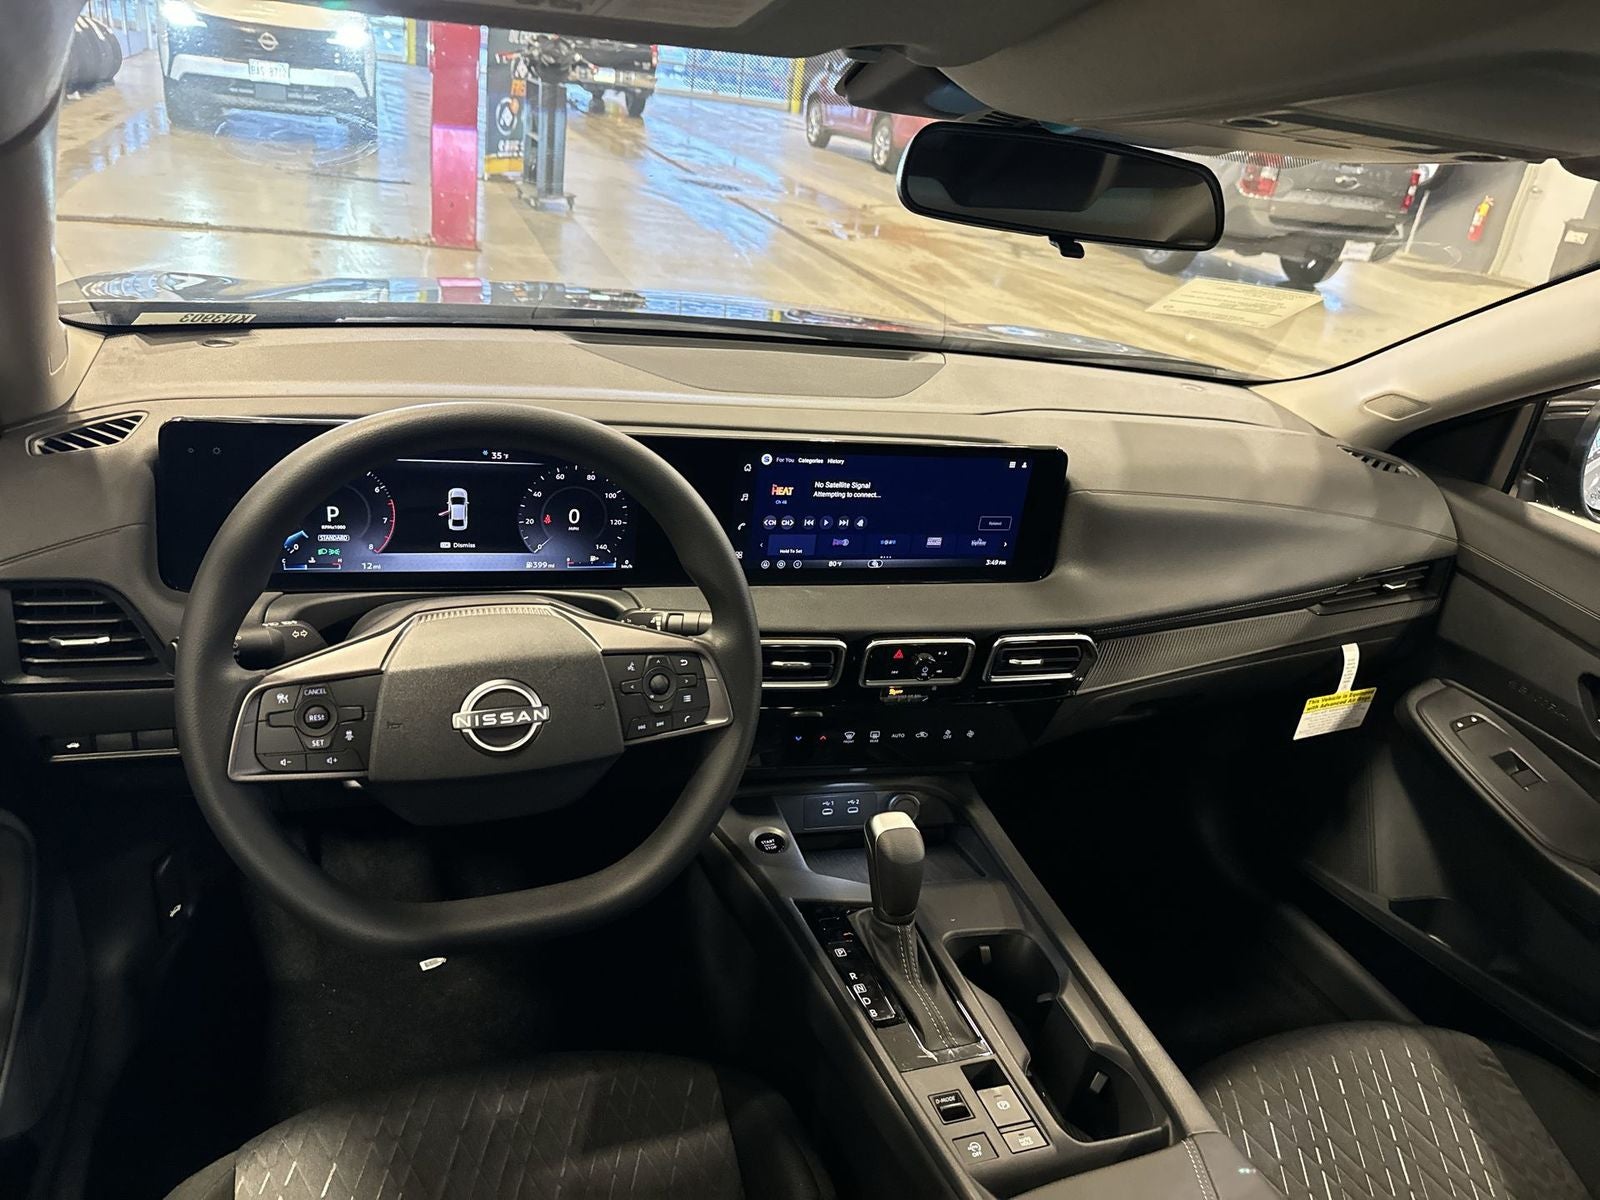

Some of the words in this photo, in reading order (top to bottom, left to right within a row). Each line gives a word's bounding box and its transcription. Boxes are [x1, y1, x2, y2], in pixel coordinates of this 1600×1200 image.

[771, 486, 794, 496] HEAT
[851, 482, 872, 490] Signal
[326, 506, 340, 522] P
[568, 508, 580, 524] 0
[456, 708, 548, 728] NISSAN
[848, 972, 858, 980] R
[862, 997, 872, 1006] D
[869, 1008, 878, 1018] B
[935, 1095, 956, 1104] D-MODE
